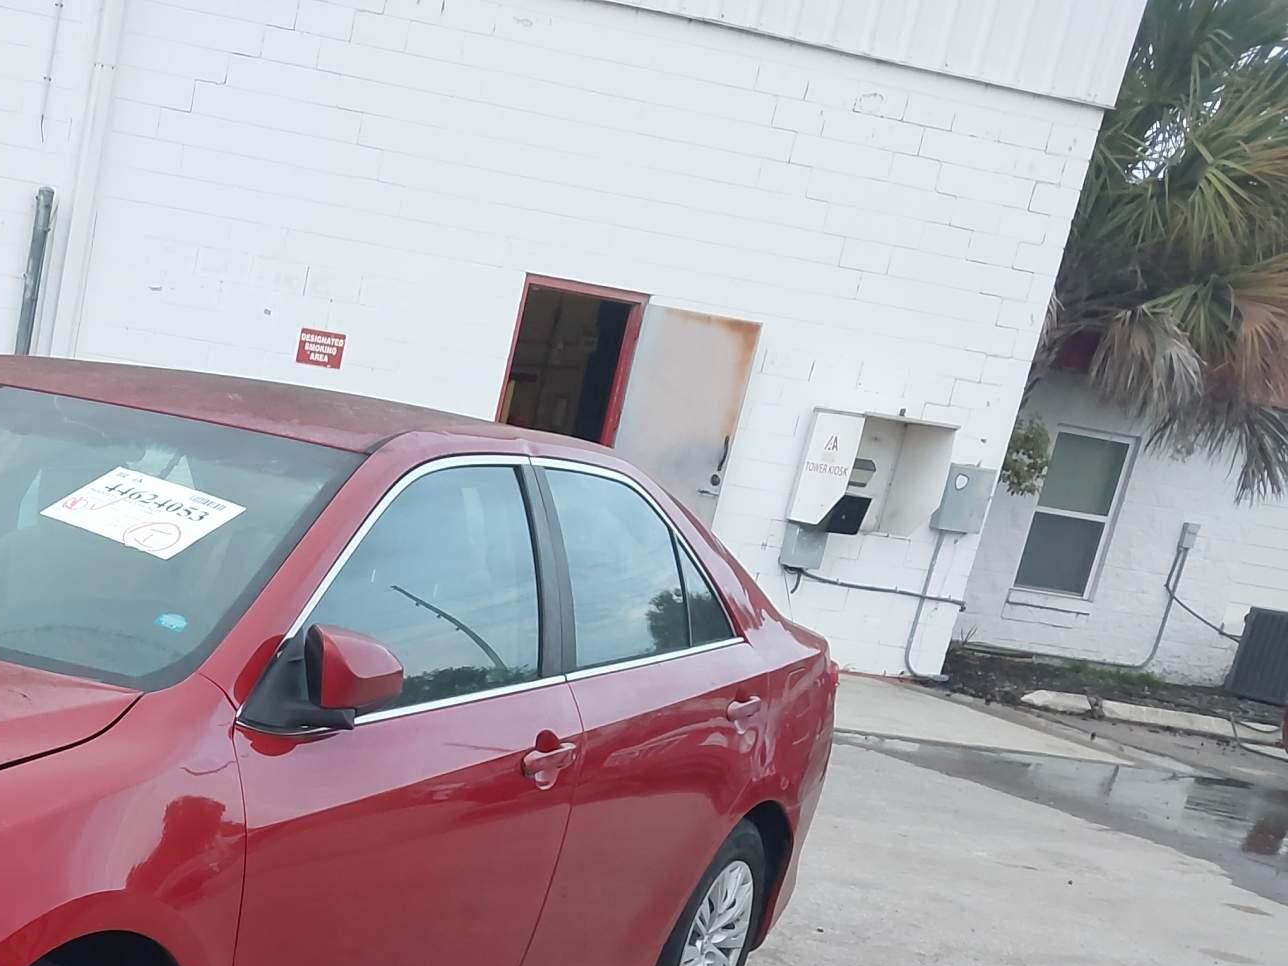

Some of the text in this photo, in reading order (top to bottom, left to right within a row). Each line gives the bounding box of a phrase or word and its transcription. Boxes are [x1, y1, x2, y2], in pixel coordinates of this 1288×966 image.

[302, 333, 344, 347] DESIGNATED
[305, 342, 337, 356] SMOKING
[309, 352, 328, 362] AREA
[806, 461, 848, 477] TOWER KIOSK
[105, 484, 209, 522] 44624053
